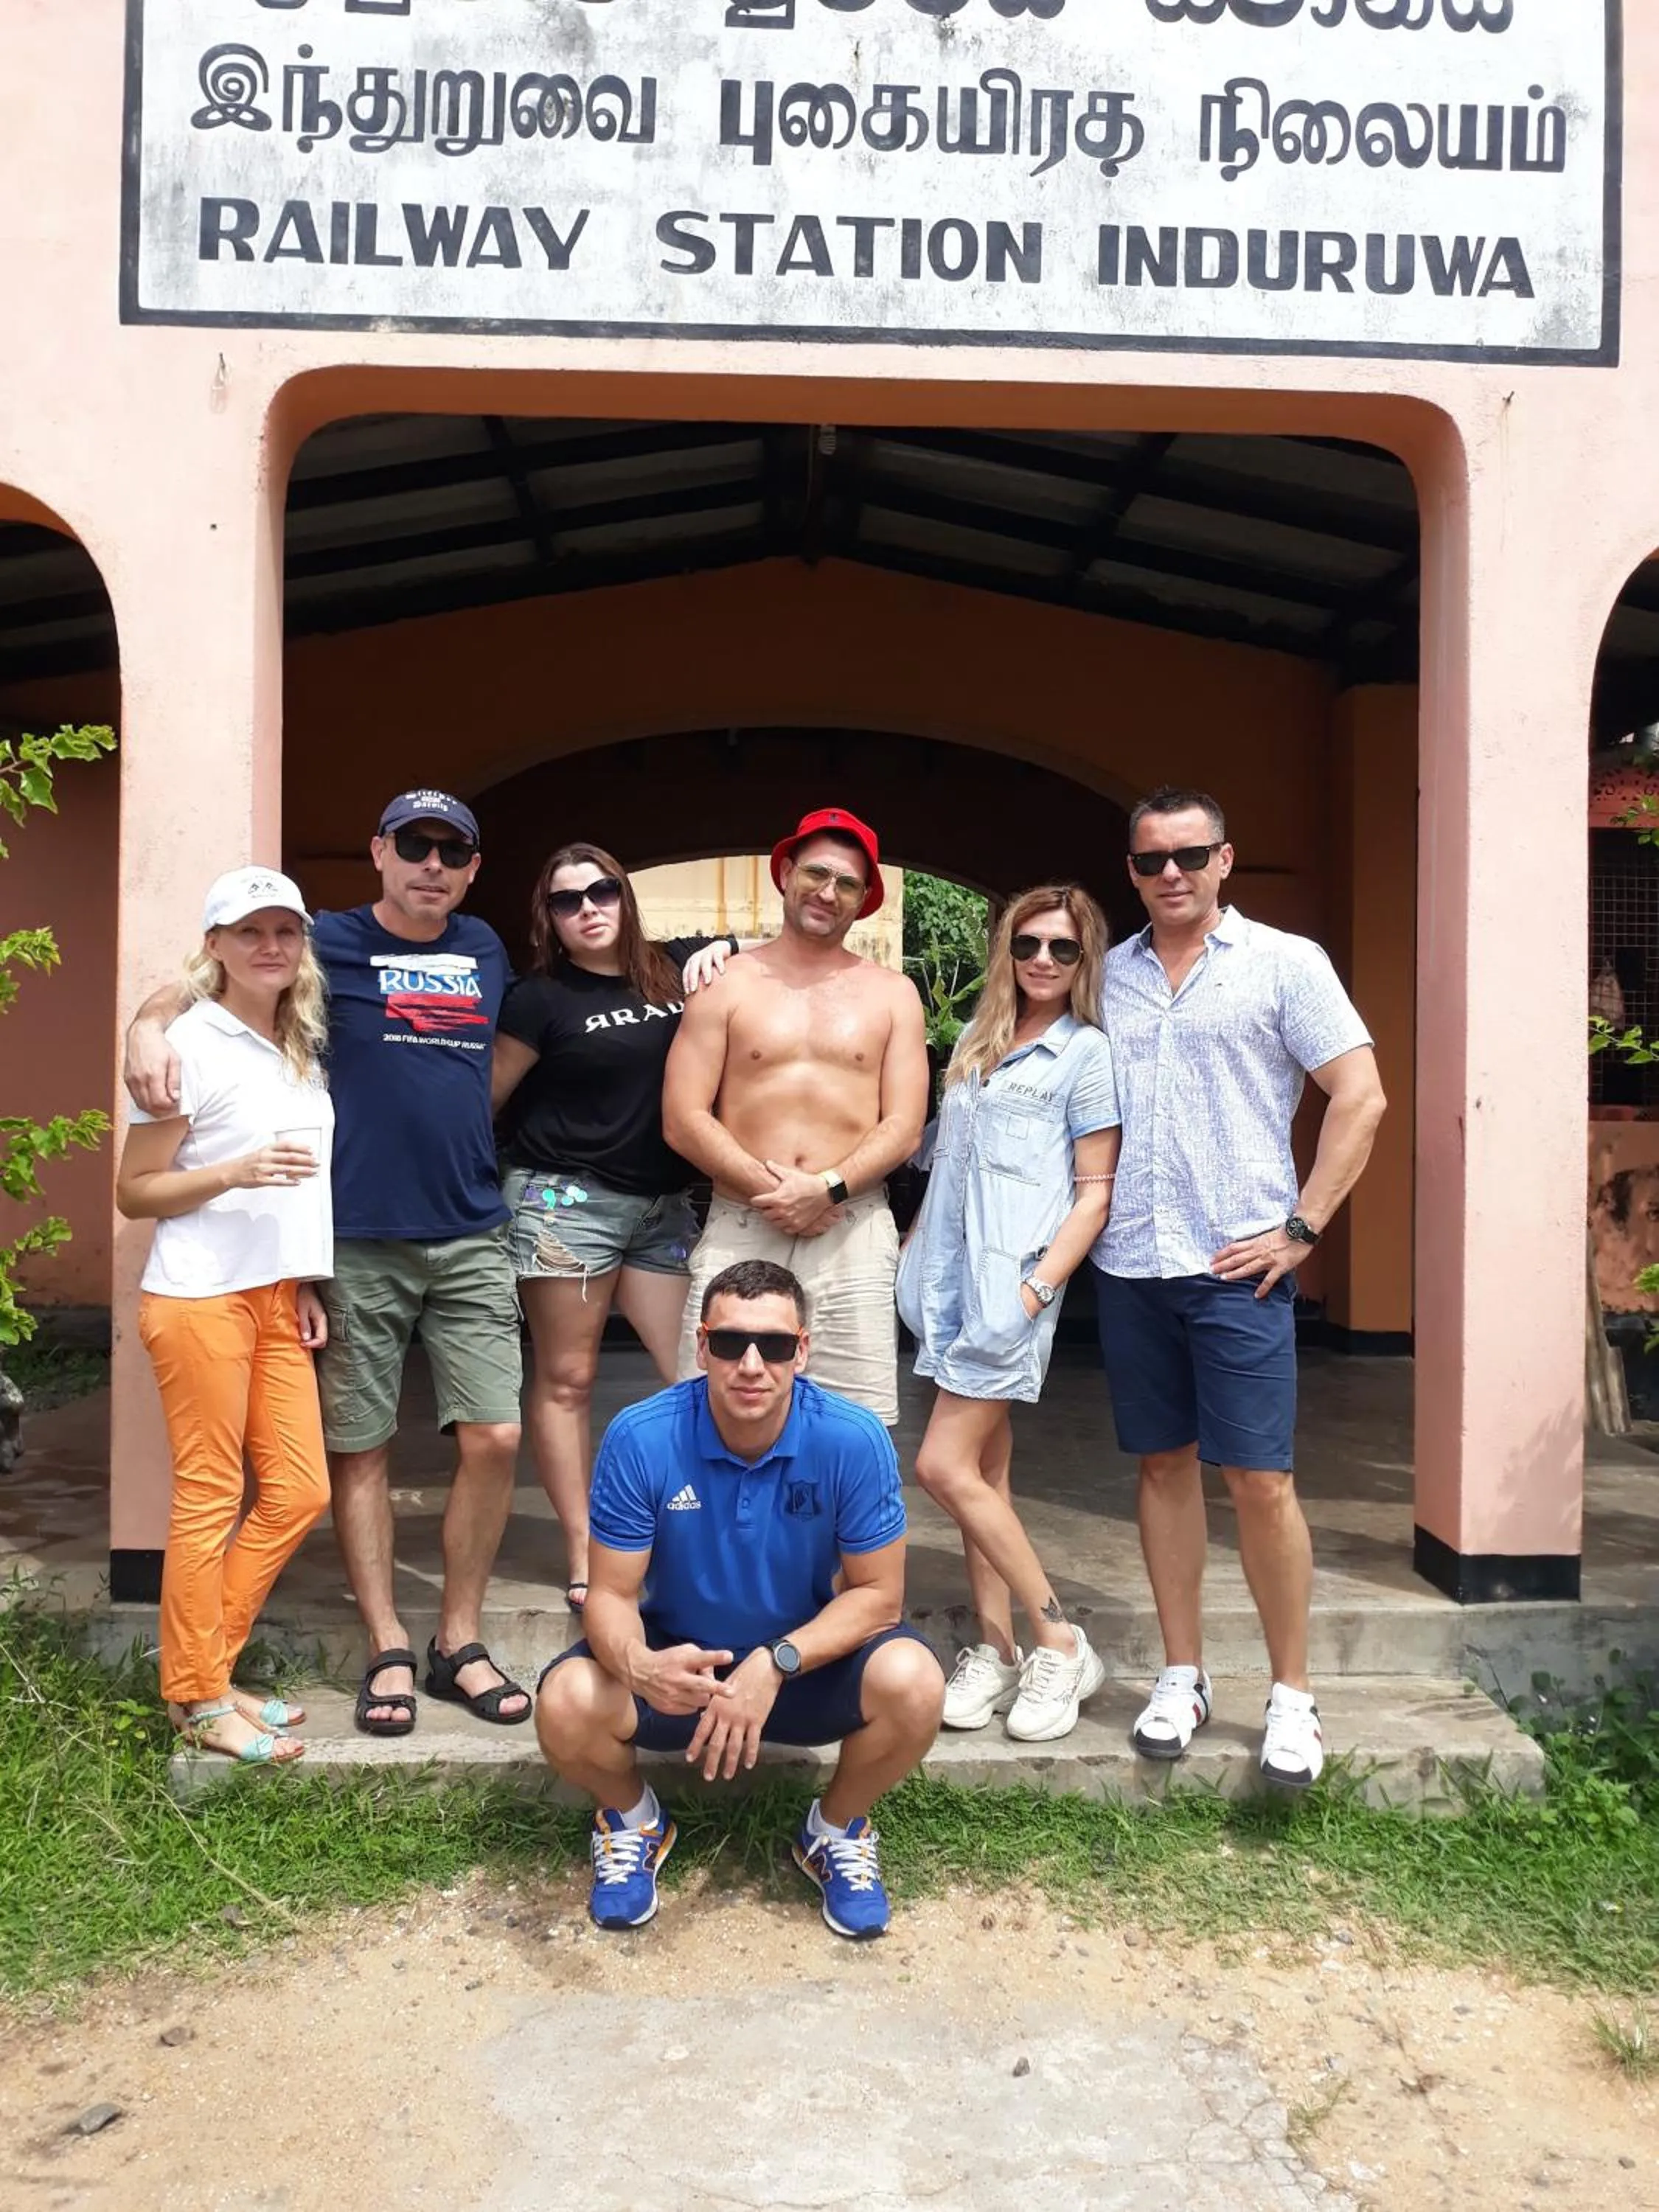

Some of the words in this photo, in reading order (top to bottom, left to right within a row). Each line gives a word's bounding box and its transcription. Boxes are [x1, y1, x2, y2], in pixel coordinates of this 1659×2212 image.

[192, 44, 657, 156] இந்துறுவை
[720, 68, 1145, 177] புகையிரத
[1200, 77, 1567, 181] நிலையம்
[199, 197, 590, 270] RAILWAY
[655, 210, 1042, 283] STATION
[1098, 224, 1535, 298] INDURUWA
[379, 970, 483, 998] RUSSIA
[402, 1034, 418, 1043] FIFA
[418, 1037, 446, 1046] WORLD
[446, 1039, 461, 1048] CUP
[1007, 1082, 1057, 1102] REPLAY
[667, 1500, 701, 1510] adidas
